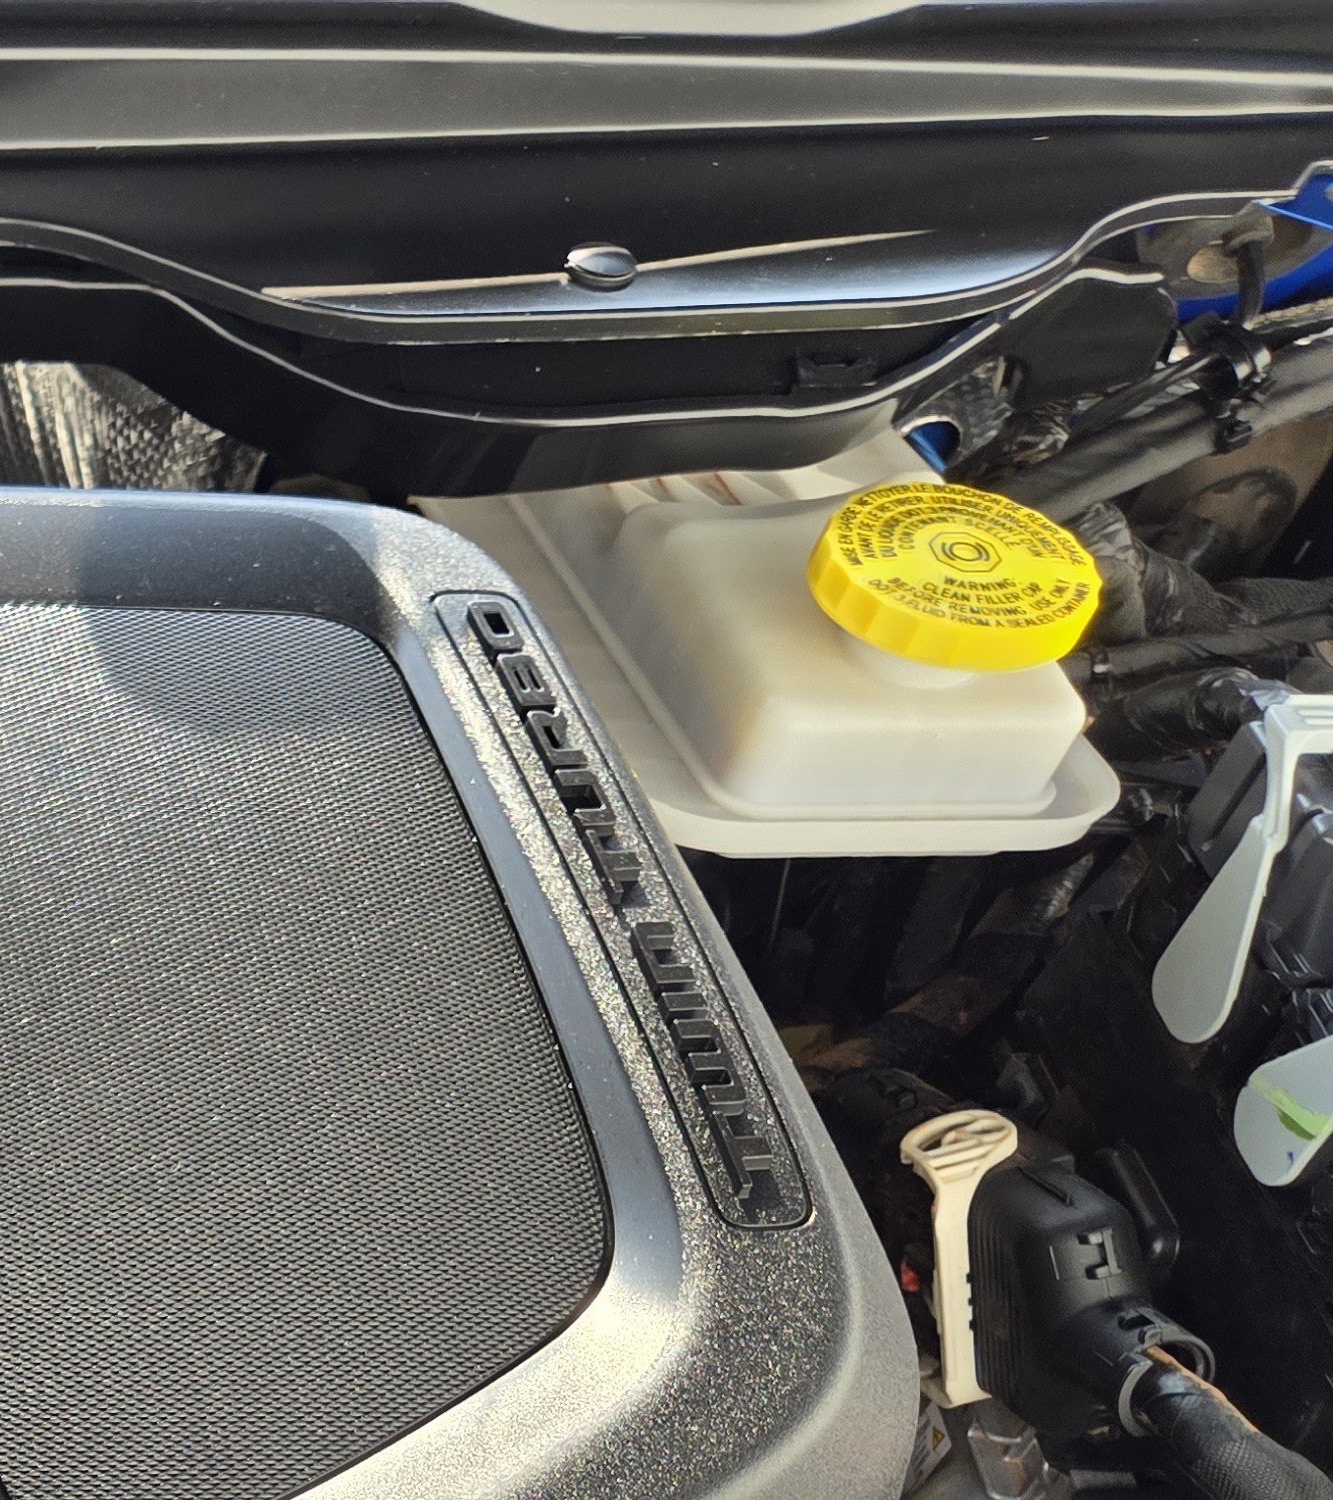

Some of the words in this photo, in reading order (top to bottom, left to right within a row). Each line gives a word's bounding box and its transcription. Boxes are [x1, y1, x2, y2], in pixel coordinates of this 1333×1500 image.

[853, 485, 911, 508] NETTOYER
[933, 485, 1002, 505] BOUCHON
[1003, 502, 1024, 515] DE
[898, 507, 924, 519] DOT
[930, 495, 994, 515] UTILISER
[858, 520, 878, 532] DE
[864, 510, 884, 523] LE
[856, 532, 879, 560] AVANT
[897, 515, 957, 550] CONTENANT
[995, 509, 1066, 560] UNIQUEMENT
[868, 579, 898, 595] DOT
[906, 600, 946, 618] FLUID
[951, 613, 993, 628] FROM
[995, 618, 1006, 628] A
[1006, 613, 1054, 628] SEALED
[1052, 581, 1091, 619] CONTAINER
[887, 577, 943, 607] BEFORE
[1028, 596, 1056, 612] USE
[1049, 577, 1071, 599] ONLY
[923, 582, 971, 602] CLEAN
[976, 592, 1025, 605] FILLER
[1021, 581, 1043, 598] CAP
[466, 601, 642, 906] TURBO
